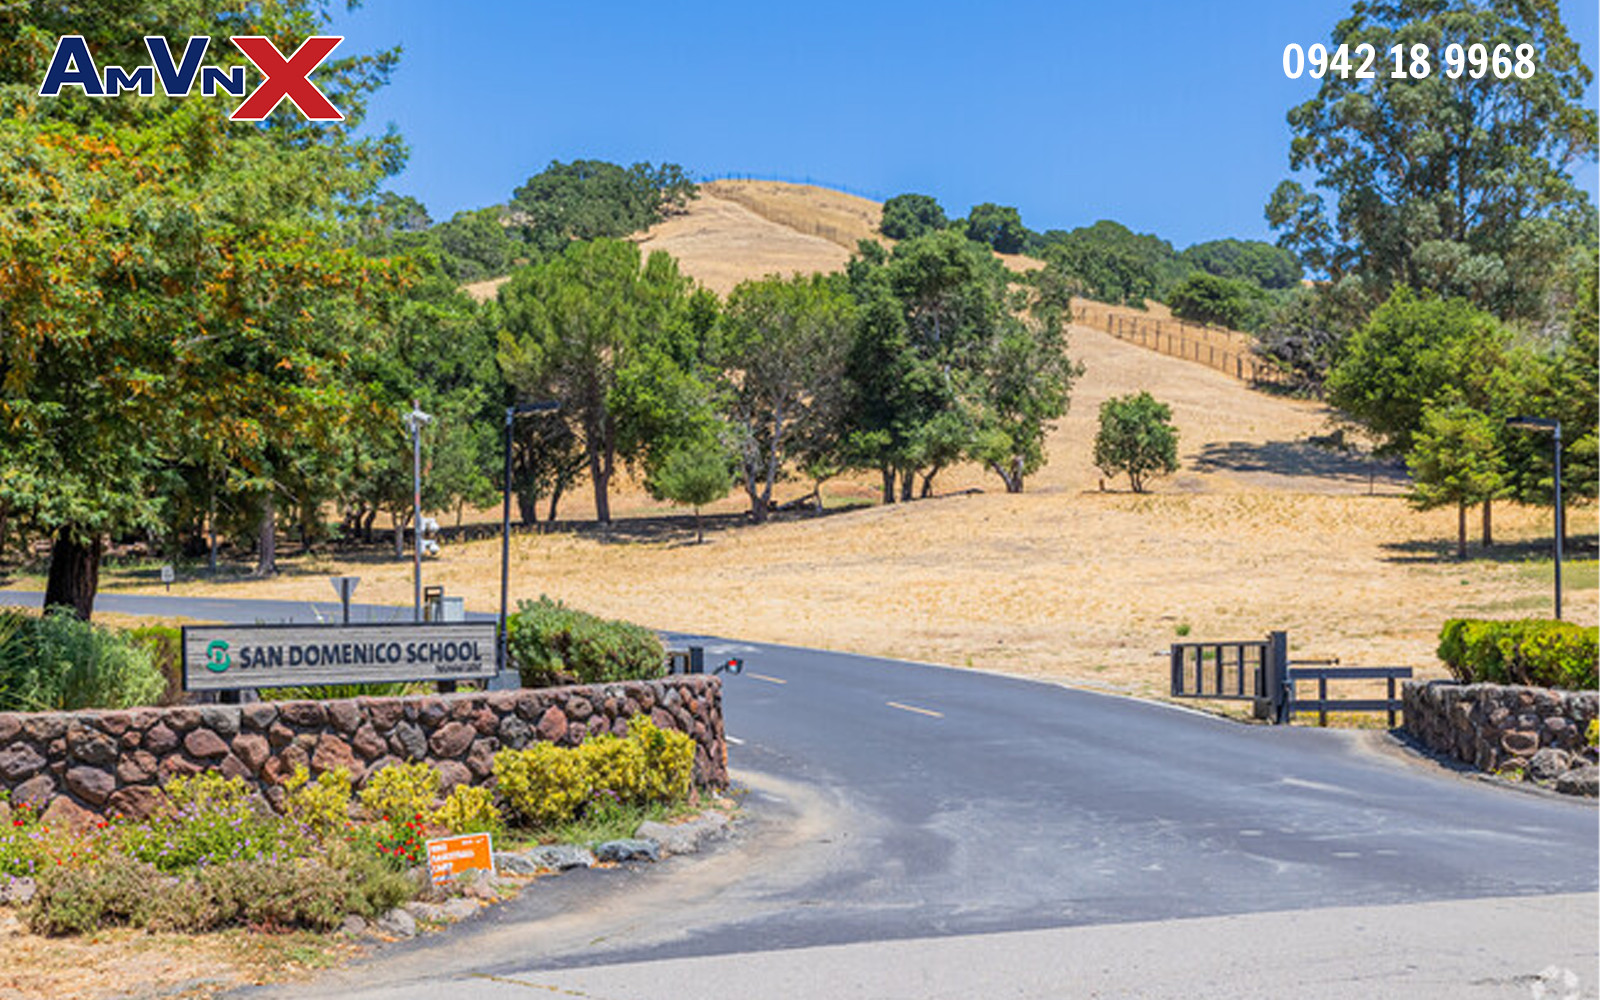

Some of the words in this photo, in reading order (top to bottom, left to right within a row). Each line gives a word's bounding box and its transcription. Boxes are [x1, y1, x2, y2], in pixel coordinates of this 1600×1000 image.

[240, 645, 283, 669] SAN
[289, 642, 402, 666] DOMENICO
[406, 641, 482, 663] SCHOOL
